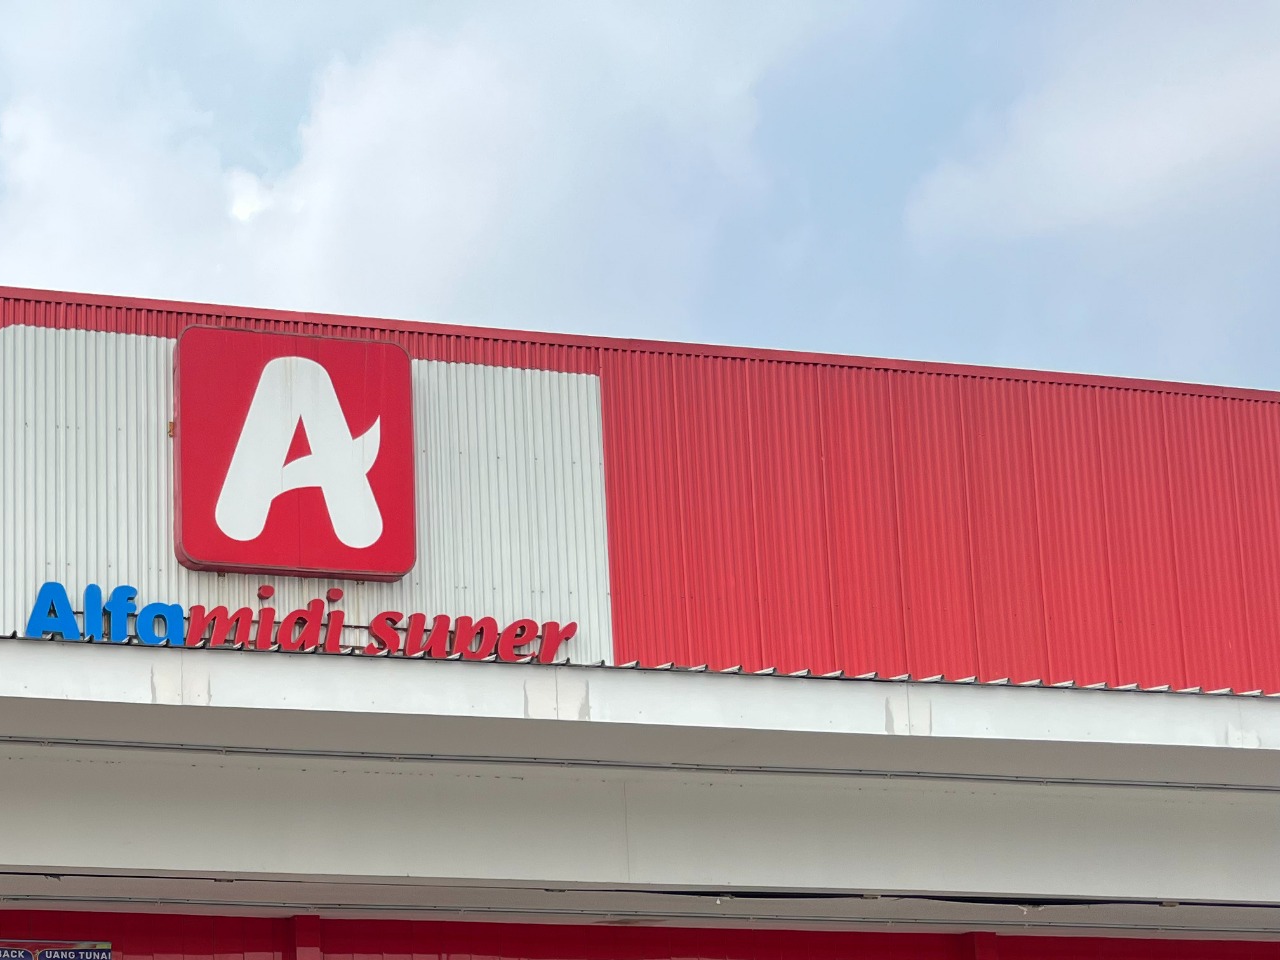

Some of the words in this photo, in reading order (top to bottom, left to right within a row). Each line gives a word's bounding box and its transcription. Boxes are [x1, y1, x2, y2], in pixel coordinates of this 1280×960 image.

[25, 581, 345, 652] Alfamidi
[45, 951, 76, 959] UANG
[79, 952, 111, 960] TUNAI
